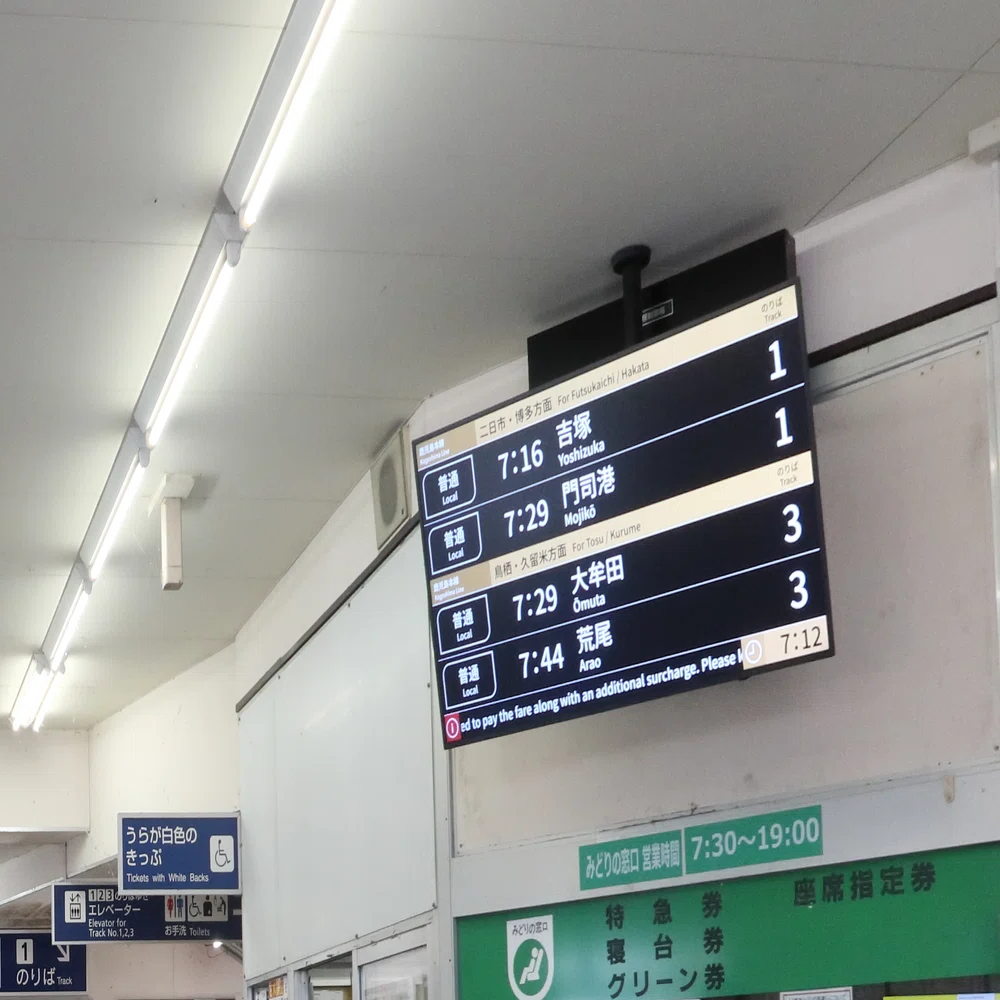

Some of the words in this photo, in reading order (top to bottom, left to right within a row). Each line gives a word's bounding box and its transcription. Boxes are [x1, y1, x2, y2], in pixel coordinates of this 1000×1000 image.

[761, 297, 783, 313] のりば
[764, 310, 782, 323] Track
[768, 339, 787, 381] 1
[479, 398, 553, 439] 二日市・博多方面
[557, 392, 570, 406] For
[571, 374, 615, 400] Futsukaichi
[621, 361, 650, 380] Hakata
[555, 410, 592, 449] 吉塚
[774, 406, 794, 448] 1
[497, 439, 544, 480] 7:16
[557, 438, 606, 467] Yoshizuka
[777, 461, 799, 476] のりば
[437, 469, 460, 494] 普通
[561, 464, 616, 509] 門司港
[779, 475, 798, 487] Track
[441, 492, 459, 506] Local
[503, 499, 550, 538] 7:29
[564, 504, 597, 527] Mojikō
[782, 503, 803, 544] 3
[443, 526, 466, 550] 普通
[448, 548, 464, 562] Local
[494, 543, 567, 580] 鳥栖・久留米方面
[572, 541, 585, 553] For
[586, 534, 604, 549] Tosu
[610, 522, 641, 540] Kurume
[570, 553, 625, 595] 大牟田
[788, 569, 809, 610] 3
[512, 584, 558, 622] 7:29
[572, 592, 606, 614] Ōmuta
[452, 607, 474, 630] 普通
[456, 629, 473, 643] Local
[576, 619, 613, 654] 荒尾
[780, 626, 823, 655] 7:12
[518, 642, 565, 679] 7:44
[579, 657, 601, 673] Arao
[458, 663, 480, 686] 普通
[462, 685, 479, 698] Local
[471, 716, 482, 728] to
[482, 712, 498, 730] pay
[499, 708, 514, 723] the
[514, 703, 532, 719] fare
[533, 698, 560, 714] along
[559, 691, 581, 708] with
[582, 690, 595, 702] an
[595, 673, 646, 699] additional
[646, 659, 700, 689] surcharge.
[701, 654, 736, 673] Please
[125, 826, 198, 845] うらが白色の
[125, 848, 163, 867] きっぷ
[585, 854, 640, 880] みどりの窓口
[641, 839, 680, 870] 営業時間
[126, 873, 149, 883] Tickets
[152, 873, 166, 883] with
[168, 872, 187, 882] White
[189, 872, 209, 882] Backs
[793, 861, 937, 907] 座席指定券
[88, 904, 141, 916] エレベーター
[88, 919, 115, 928] Elevator
[116, 919, 126, 928] for
[88, 928, 106, 938] Track
[107, 928, 135, 938] No.1,2,3
[164, 925, 187, 936] お手洗
[189, 927, 211, 936] Toilets
[511, 920, 549, 936] みどりの窓口
[21, 941, 28, 961] 1
[16, 967, 56, 986] のりば
[56, 976, 73, 986] Track
[607, 963, 726, 1000] グリーン券
